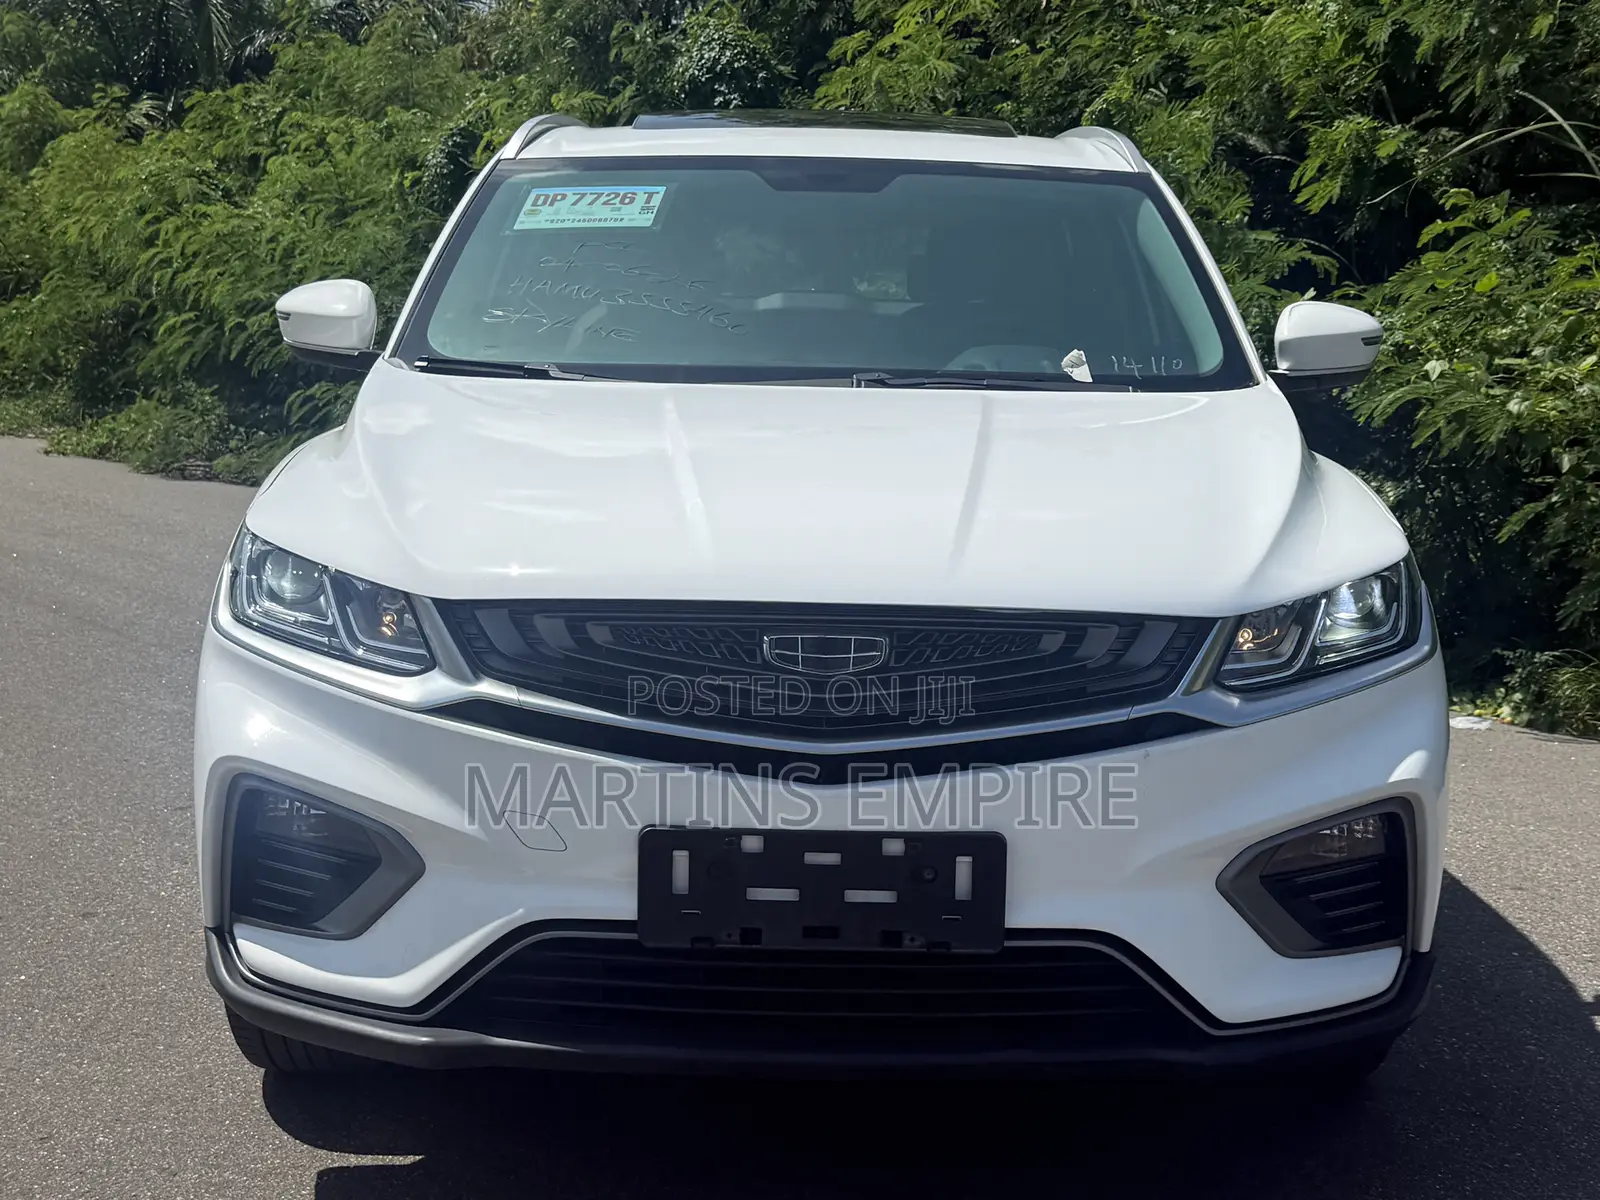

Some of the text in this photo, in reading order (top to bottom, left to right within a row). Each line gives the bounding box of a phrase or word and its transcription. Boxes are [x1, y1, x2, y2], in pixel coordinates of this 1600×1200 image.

[531, 191, 660, 207] DP 7726 T
